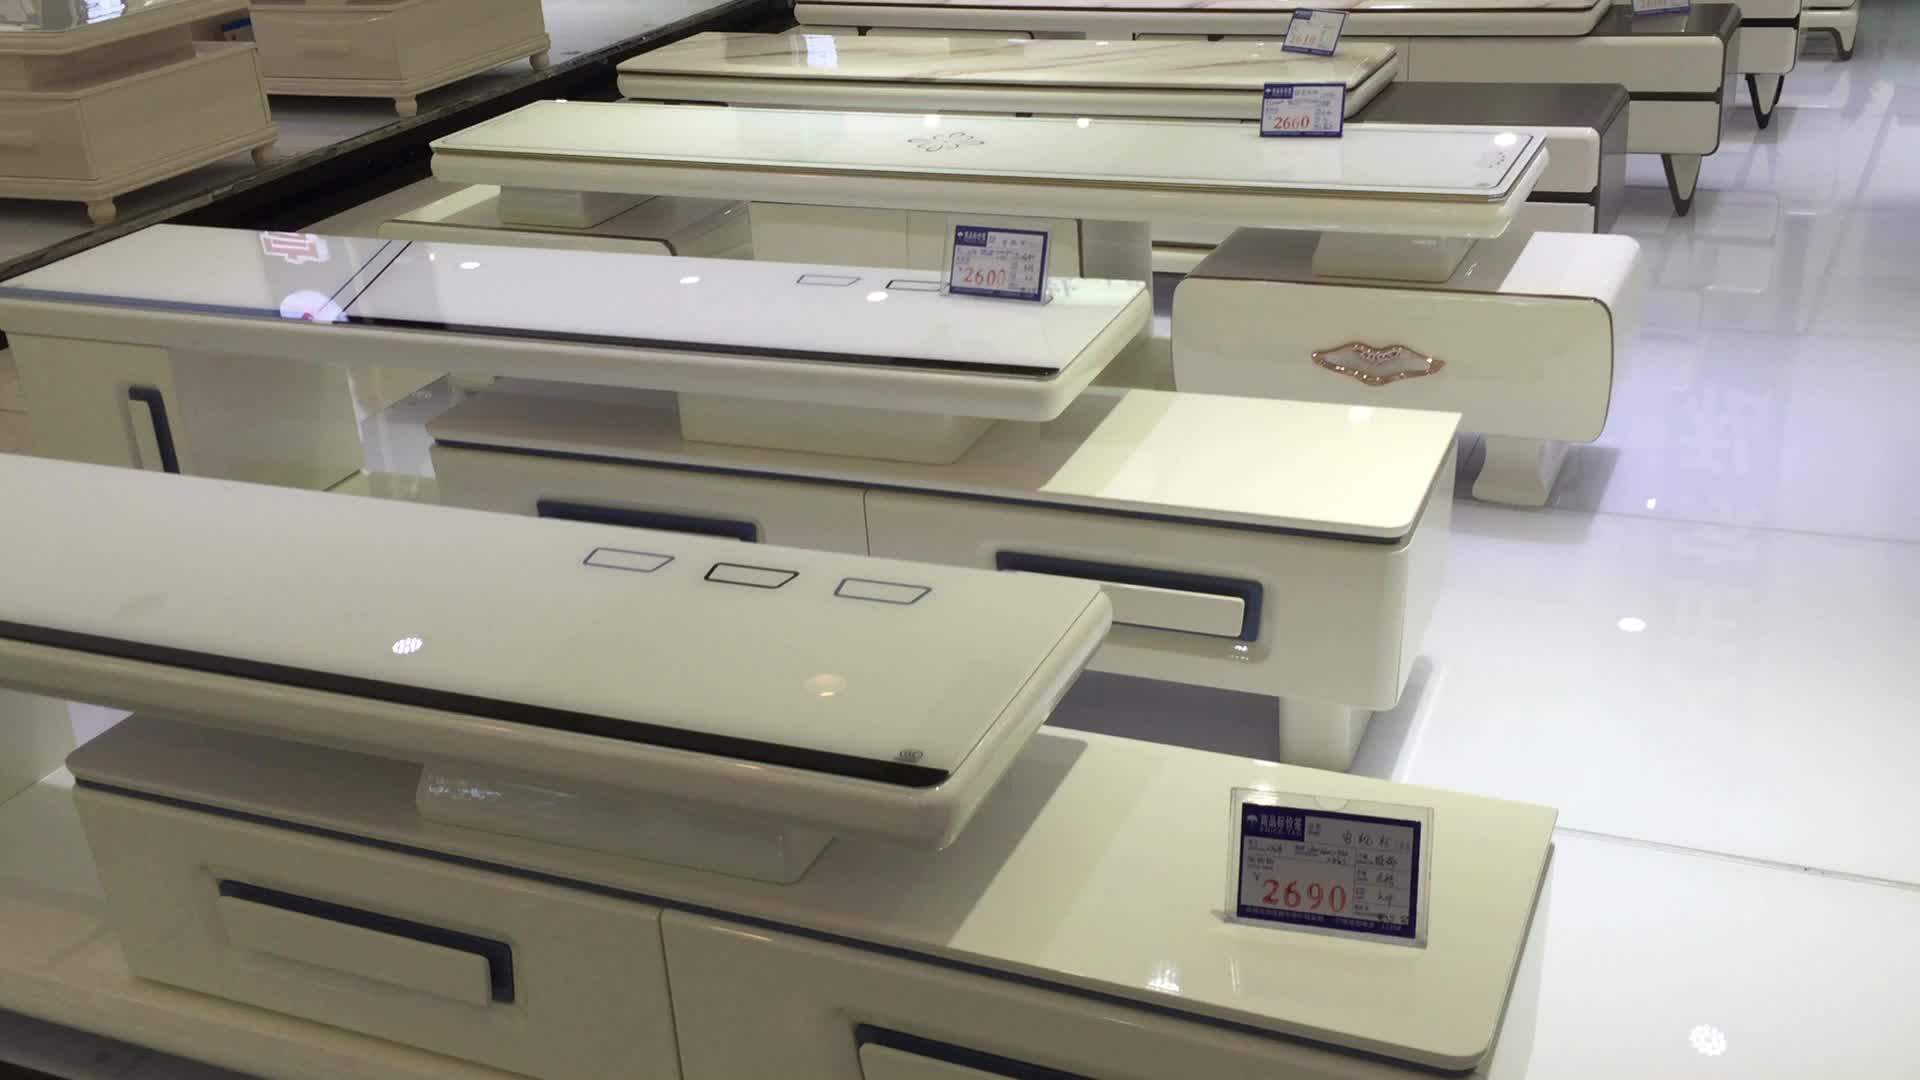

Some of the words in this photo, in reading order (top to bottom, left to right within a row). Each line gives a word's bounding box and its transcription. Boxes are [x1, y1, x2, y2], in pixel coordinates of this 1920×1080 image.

[1273, 115, 1310, 130] 2660
[963, 267, 1006, 286] 2600
[1262, 879, 1347, 913] 2690
